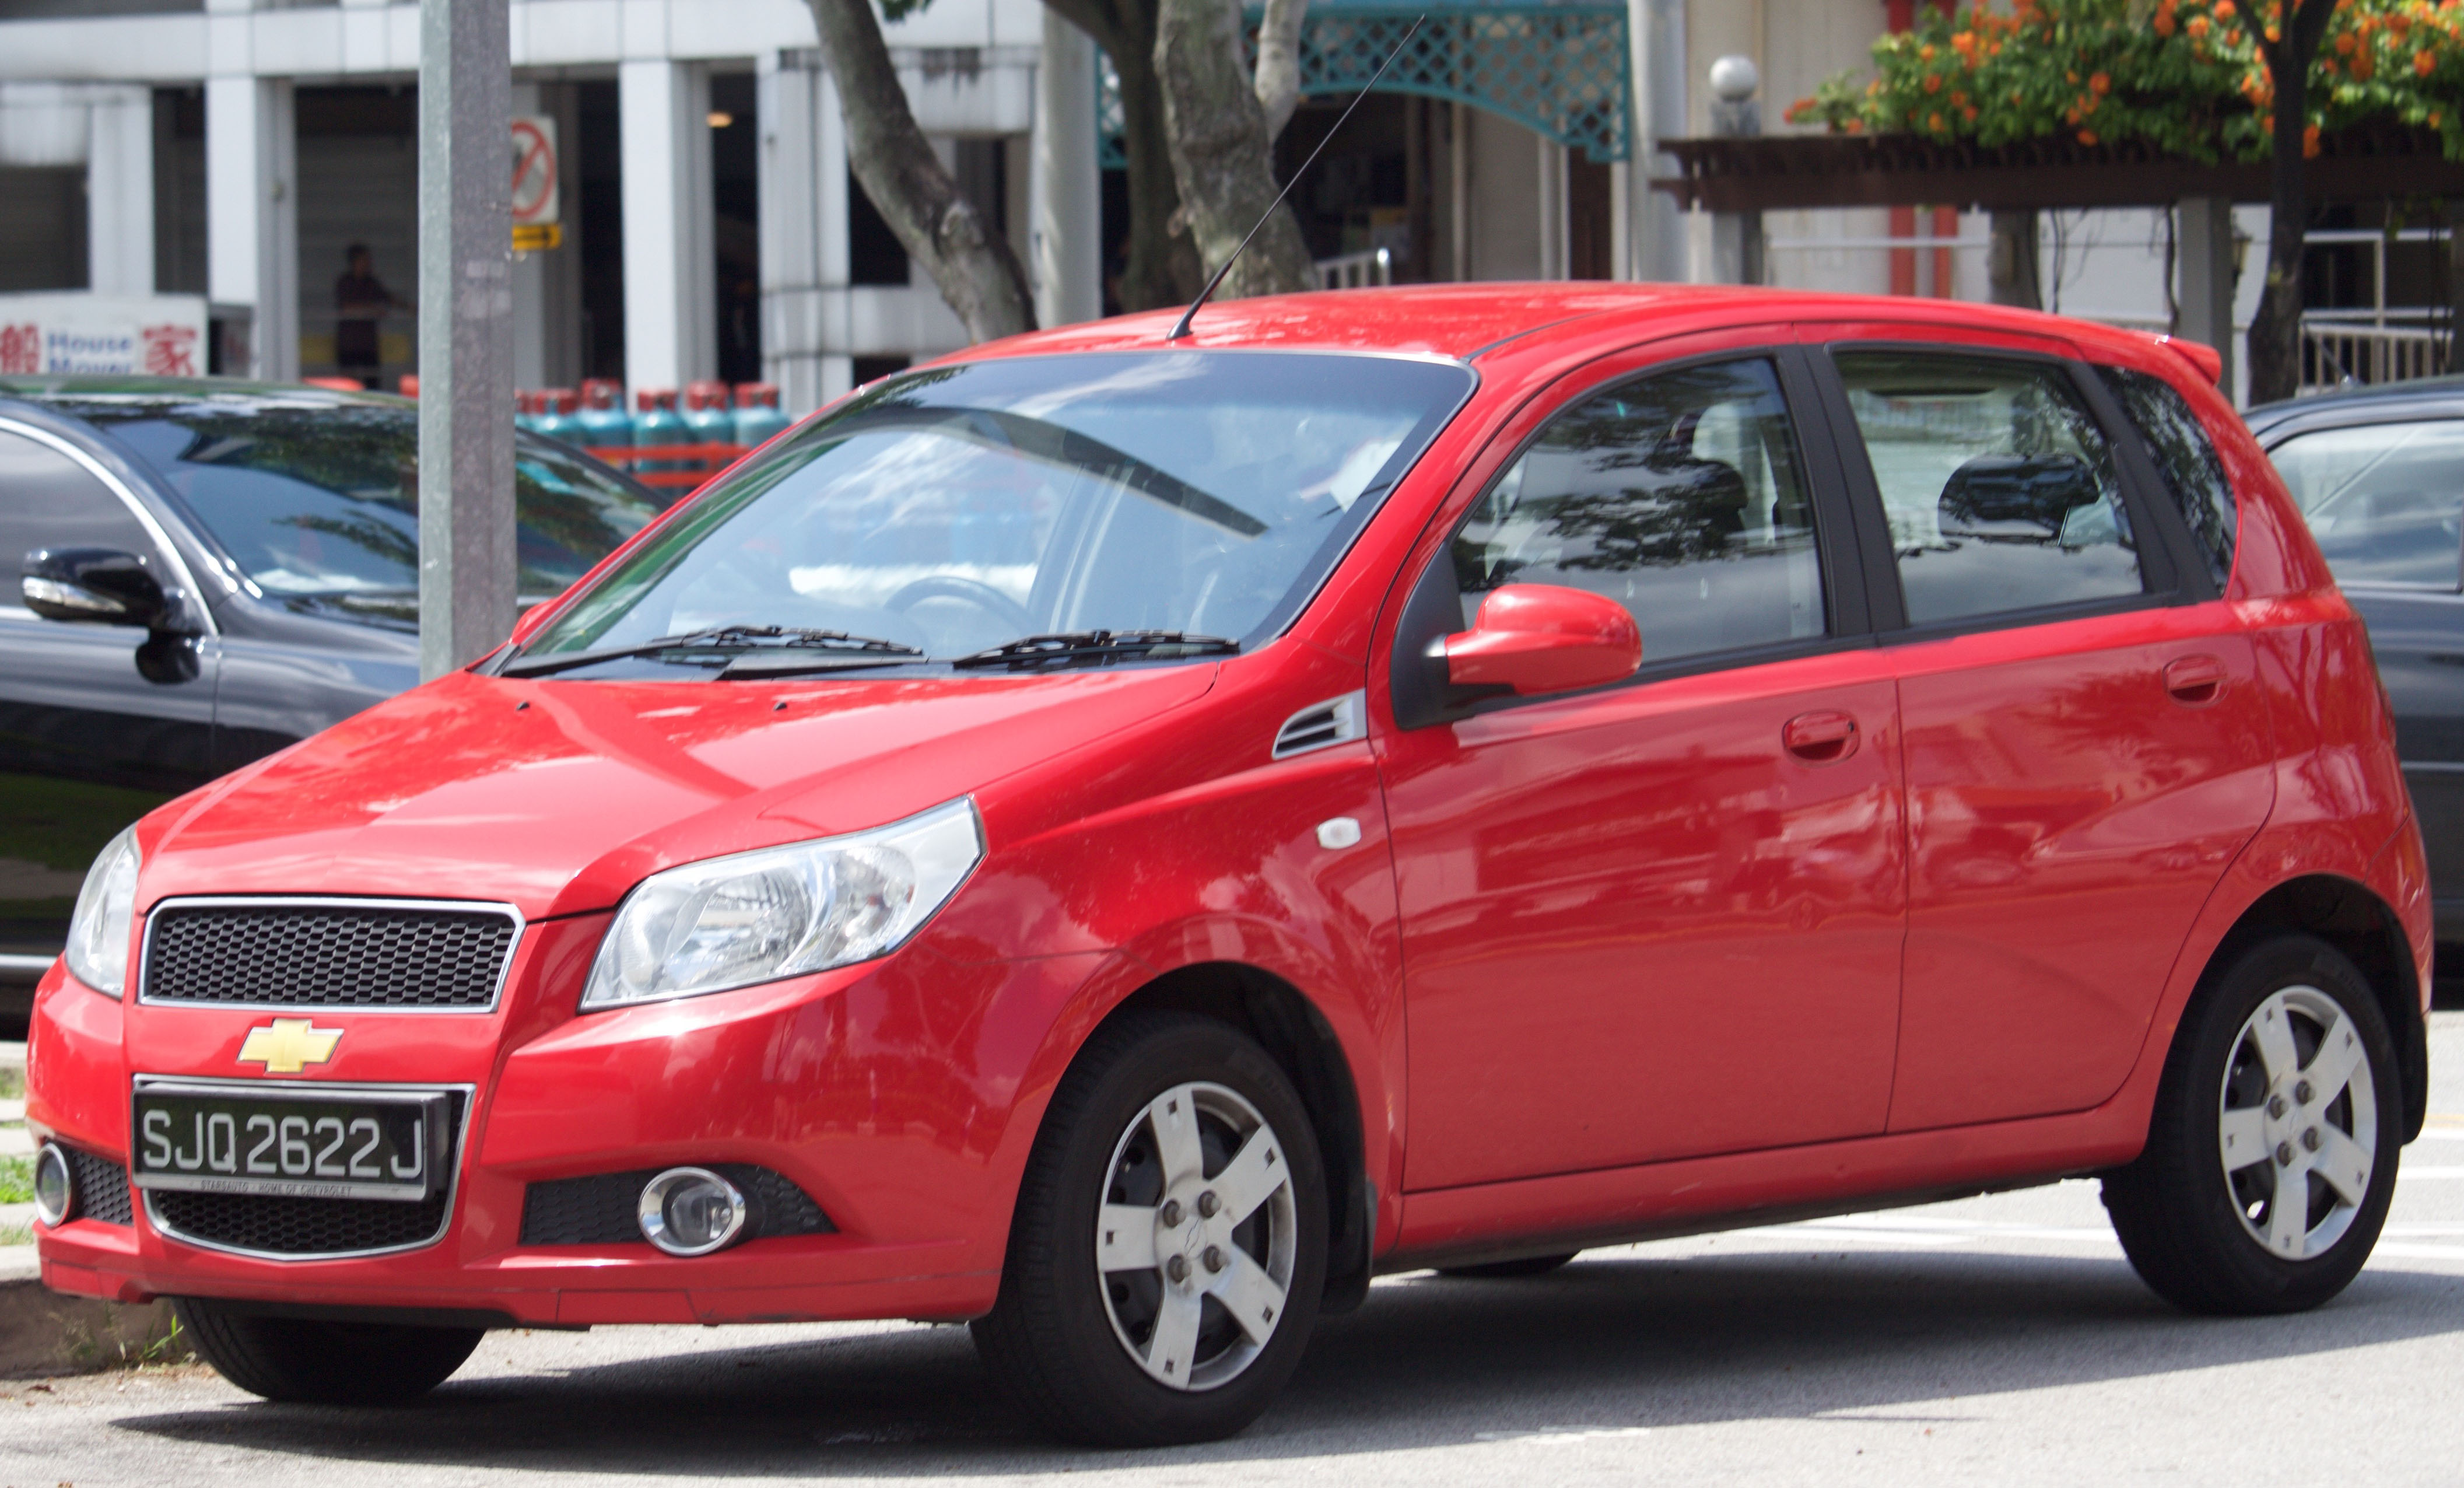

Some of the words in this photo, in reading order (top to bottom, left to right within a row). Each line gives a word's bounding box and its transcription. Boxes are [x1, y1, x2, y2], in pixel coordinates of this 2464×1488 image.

[49, 331, 131, 353] House
[143, 324, 197, 376] 家
[258, 1183, 283, 1195] HOME
[286, 1184, 297, 1195] OF
[300, 1185, 353, 1196] CHEVROLET
